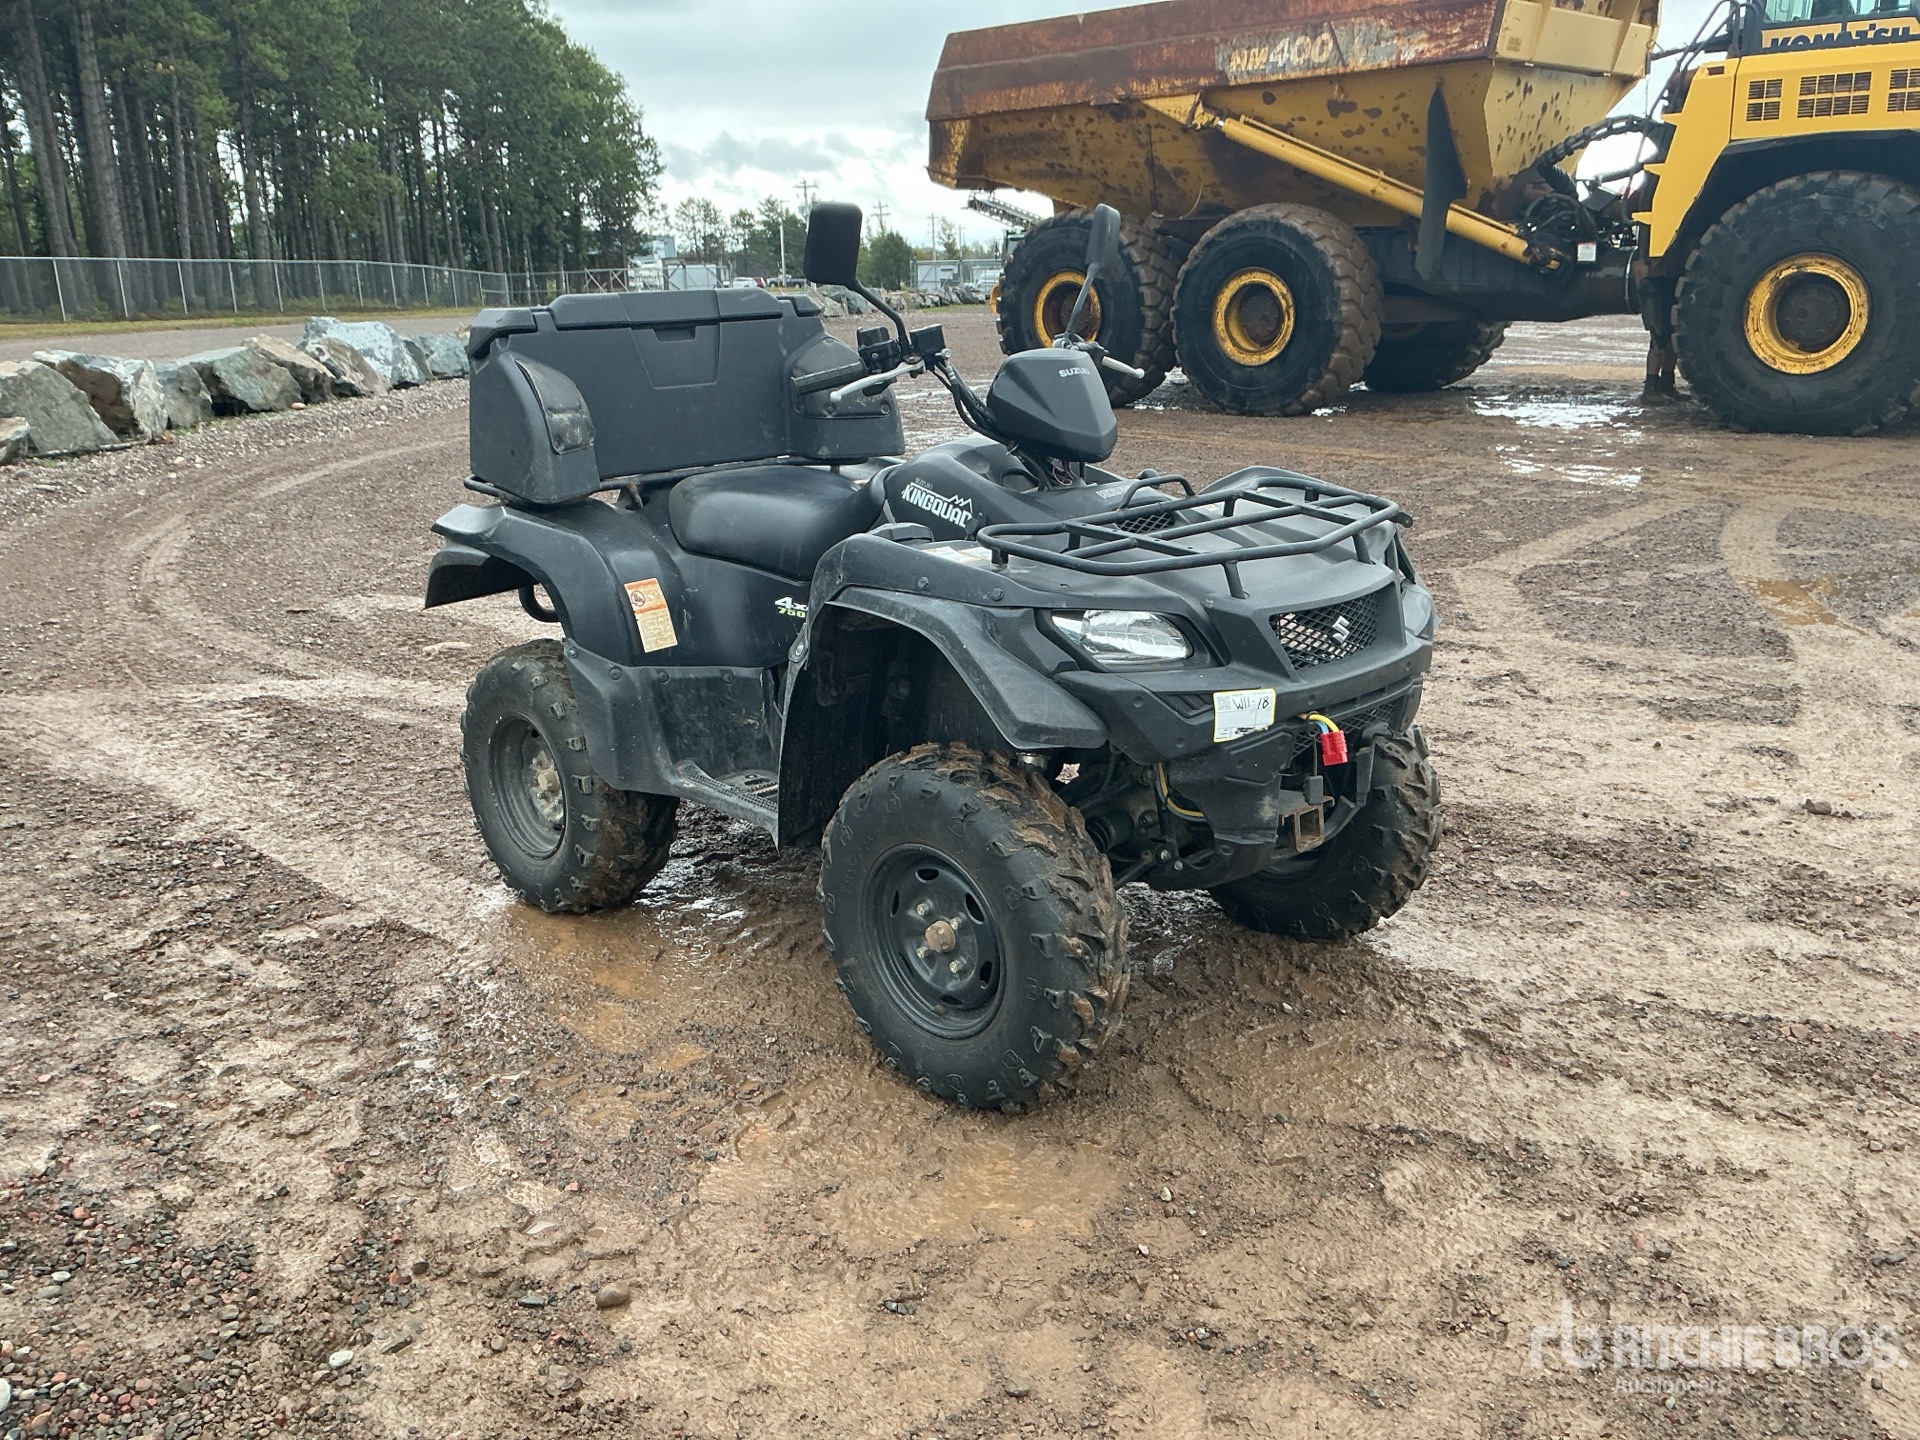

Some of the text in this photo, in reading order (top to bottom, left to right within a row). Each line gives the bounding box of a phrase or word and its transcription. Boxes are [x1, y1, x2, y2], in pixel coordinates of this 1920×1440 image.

[1058, 367, 1091, 377] SUZUKI
[774, 596, 809, 611] 4x
[777, 606, 806, 618] 750
